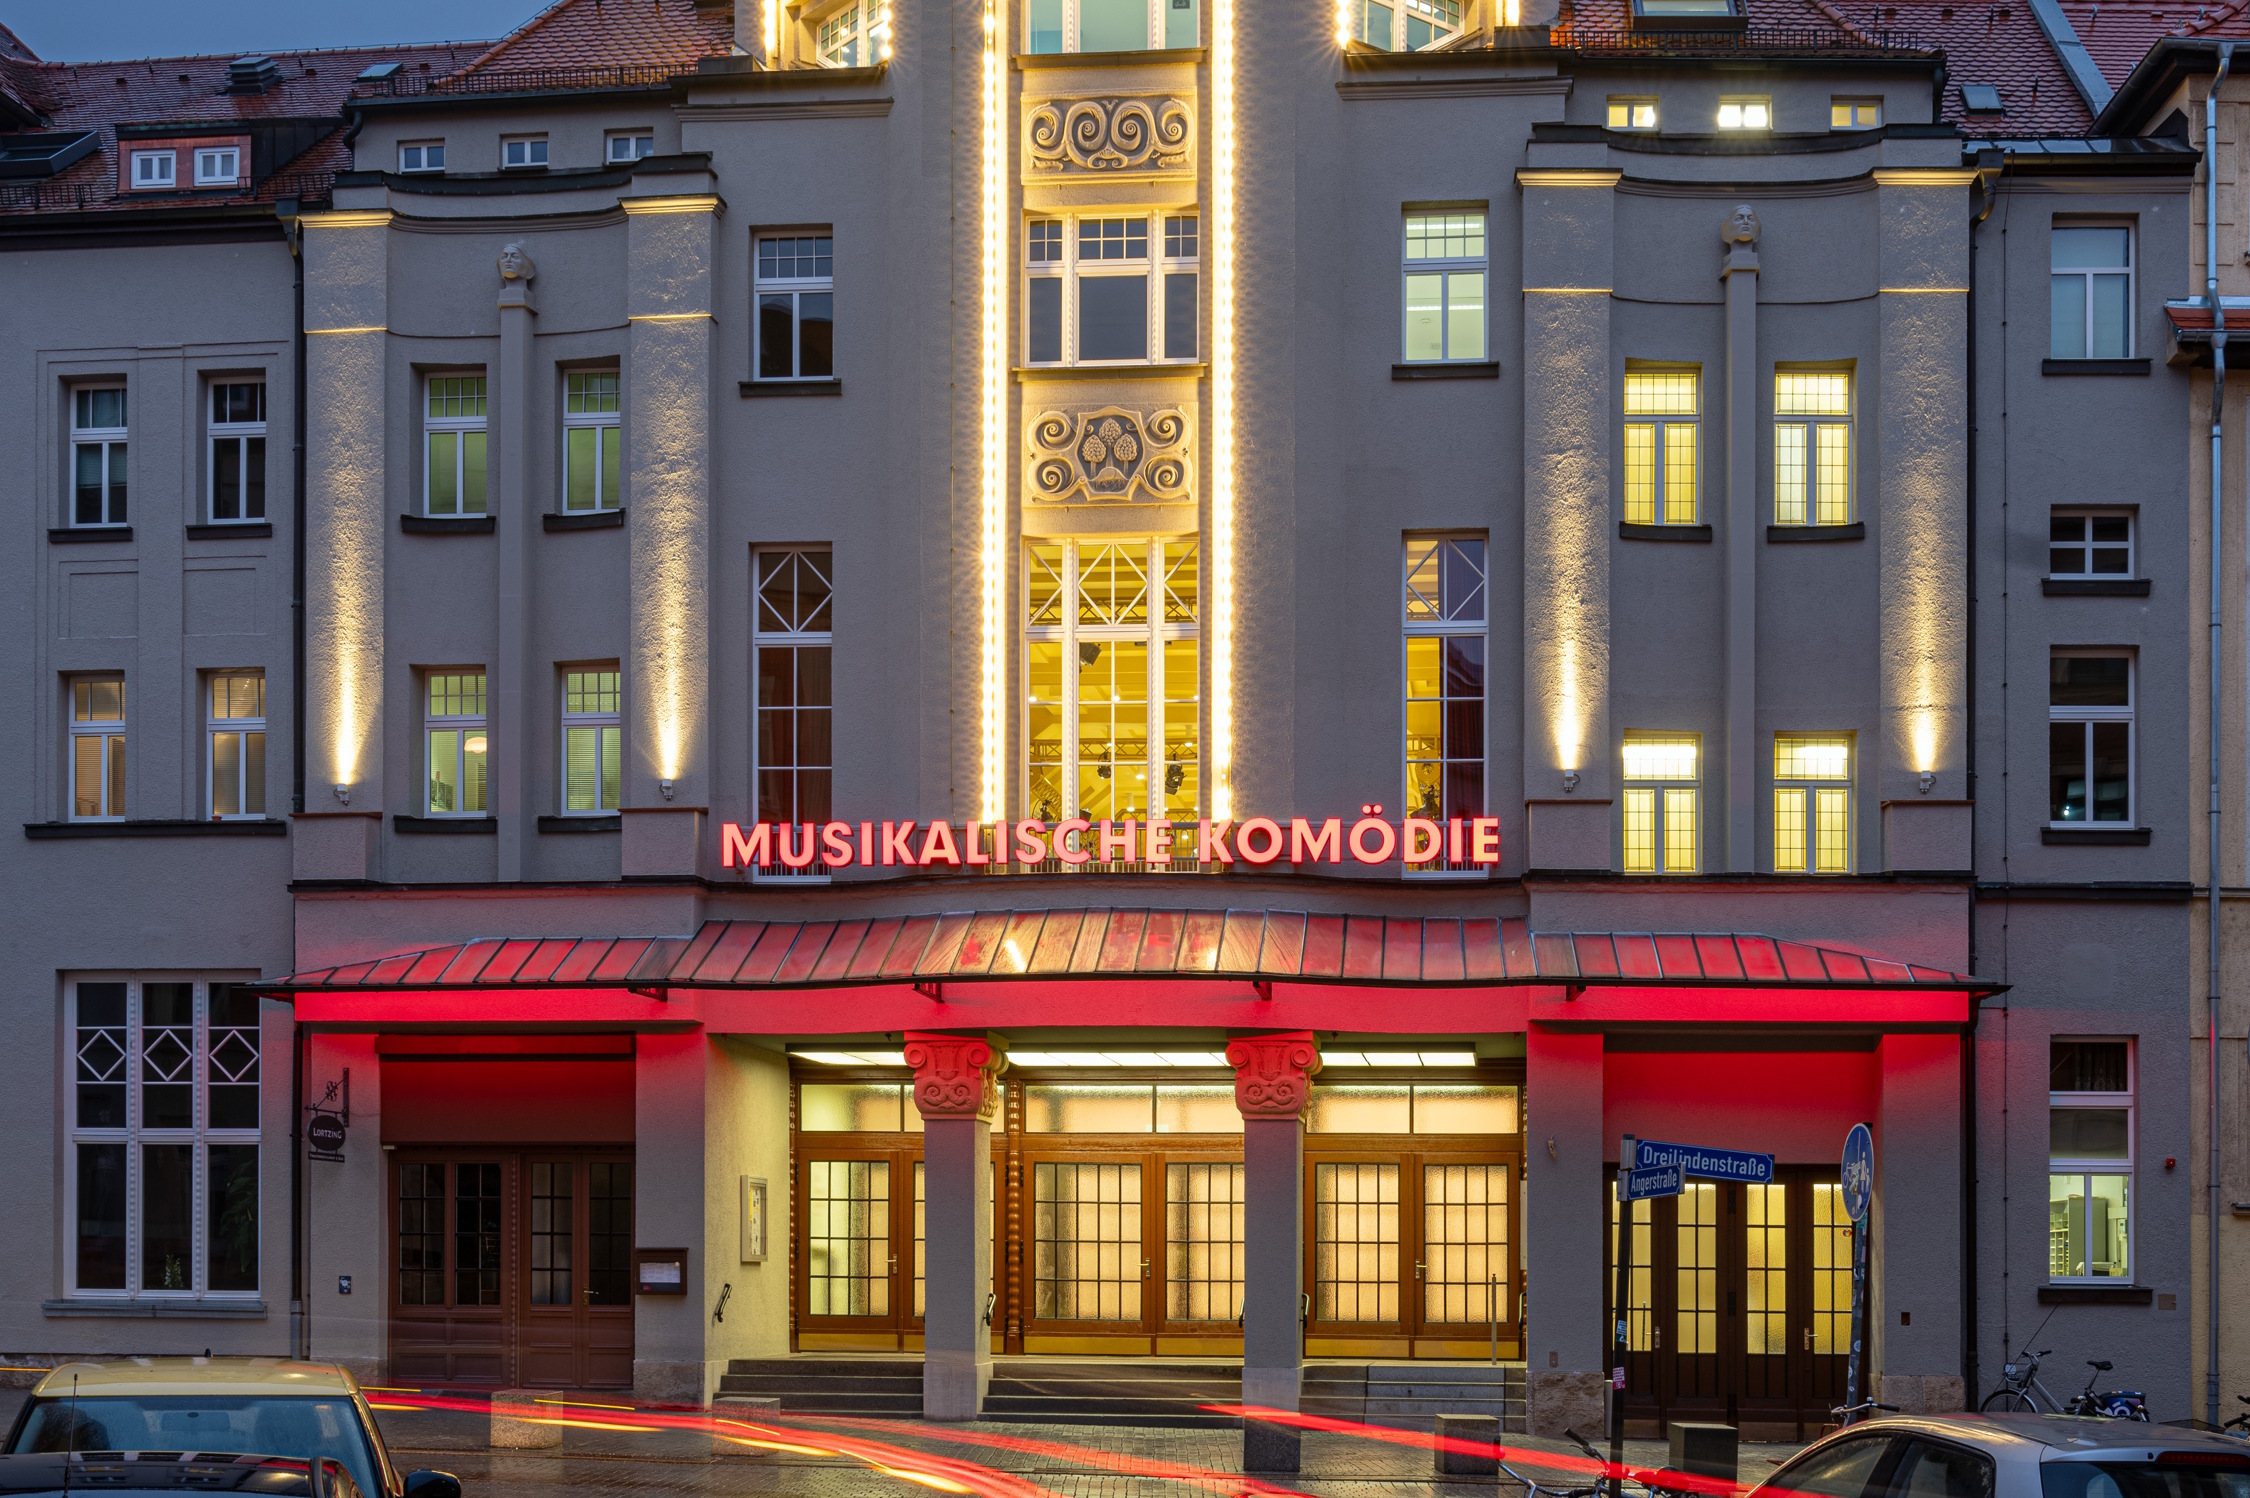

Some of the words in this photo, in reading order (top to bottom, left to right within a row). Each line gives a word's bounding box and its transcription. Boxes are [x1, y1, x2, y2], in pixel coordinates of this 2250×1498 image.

[722, 817, 1172, 868] MUSIKALISCHE
[1199, 804, 1500, 865] KOMÖDIE
[1643, 1146, 1766, 1177] Dreilindenstraße
[1630, 1168, 1677, 1196] Angerstraße
